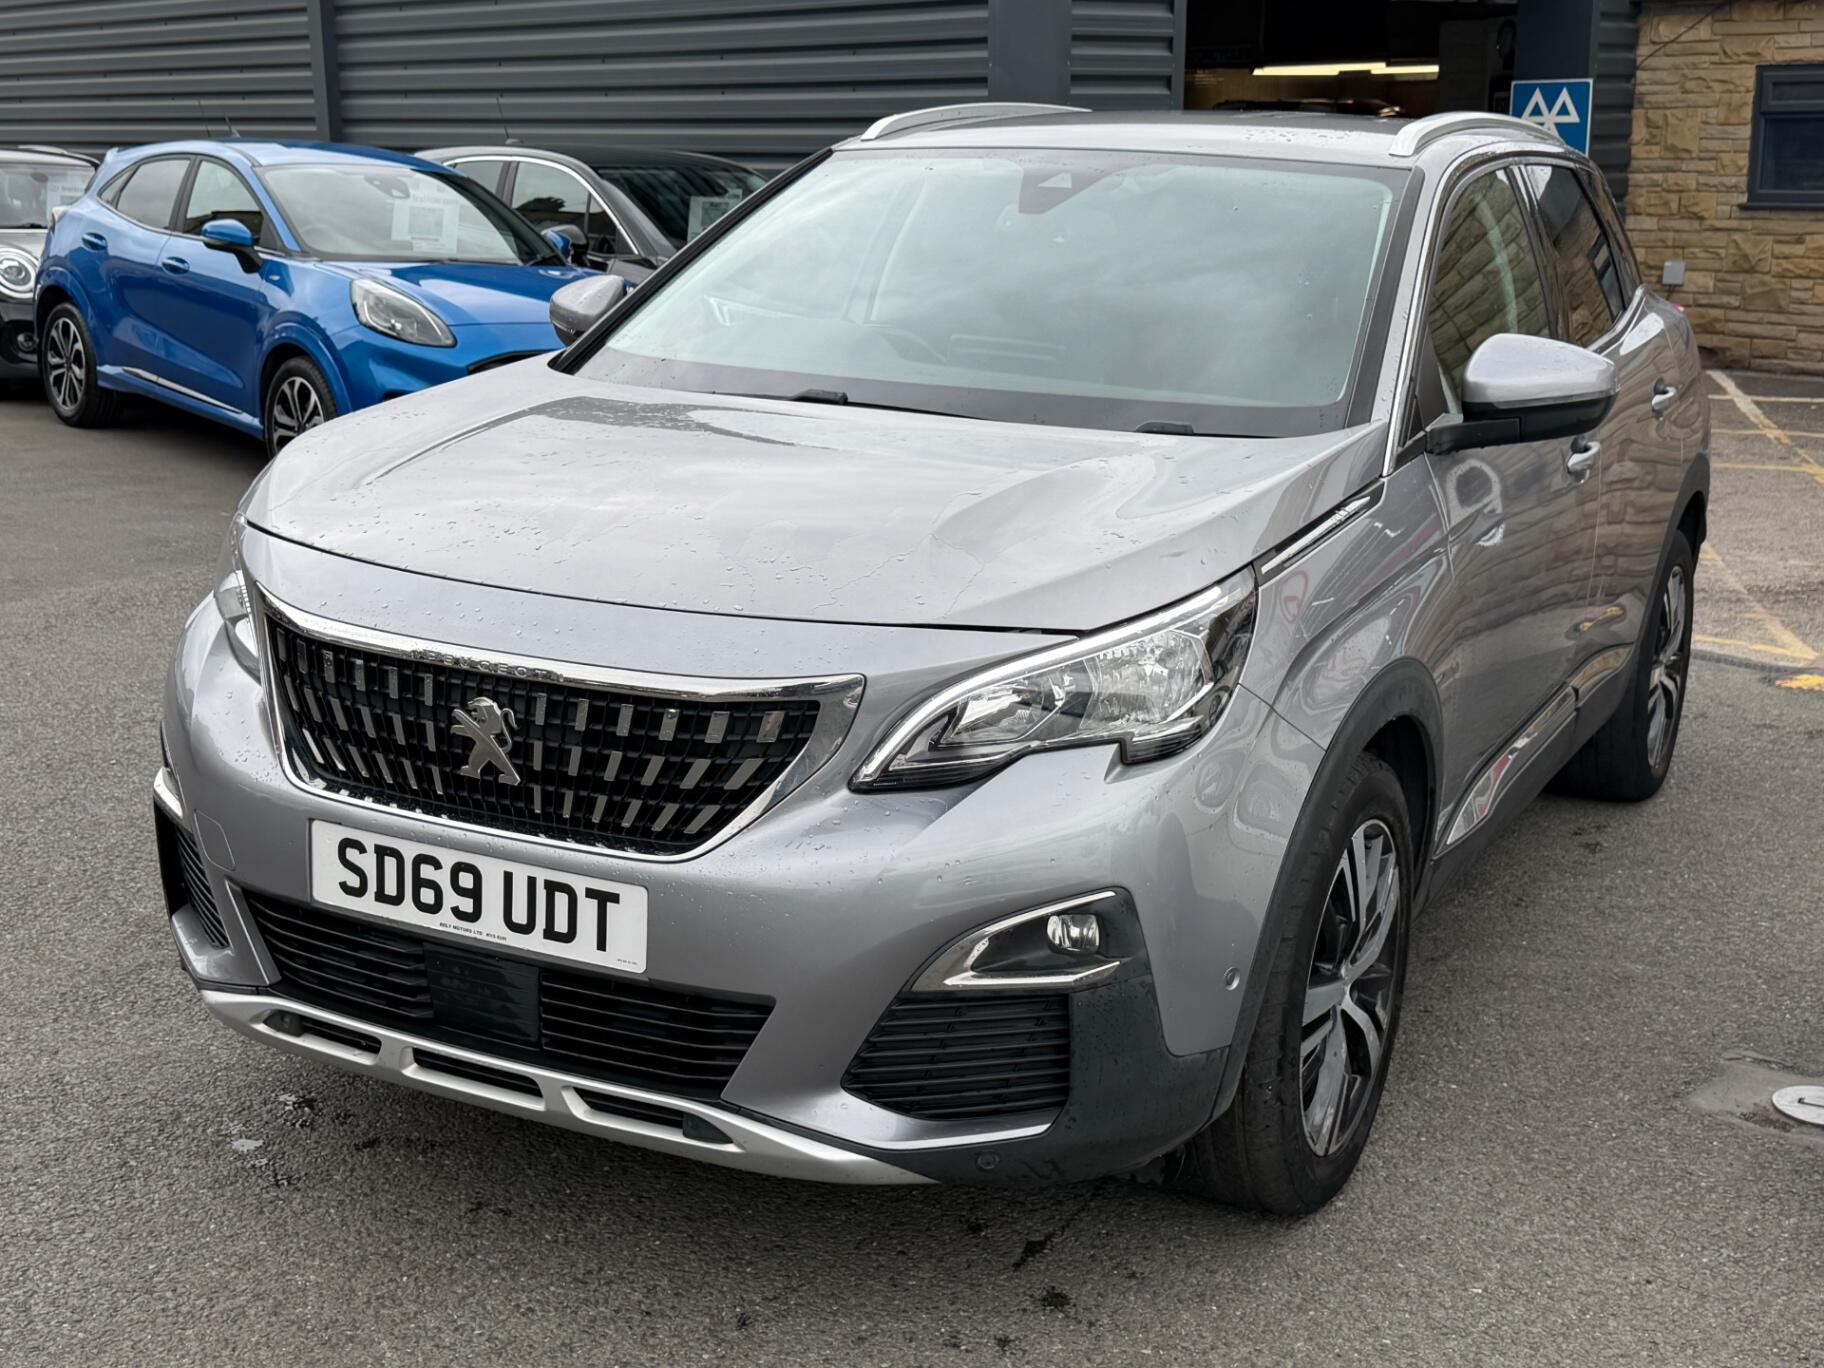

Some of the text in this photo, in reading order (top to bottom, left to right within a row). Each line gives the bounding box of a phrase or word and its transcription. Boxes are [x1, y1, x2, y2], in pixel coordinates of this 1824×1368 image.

[424, 650, 548, 681] PEUGEOT
[337, 838, 620, 952] SD69 UDT
